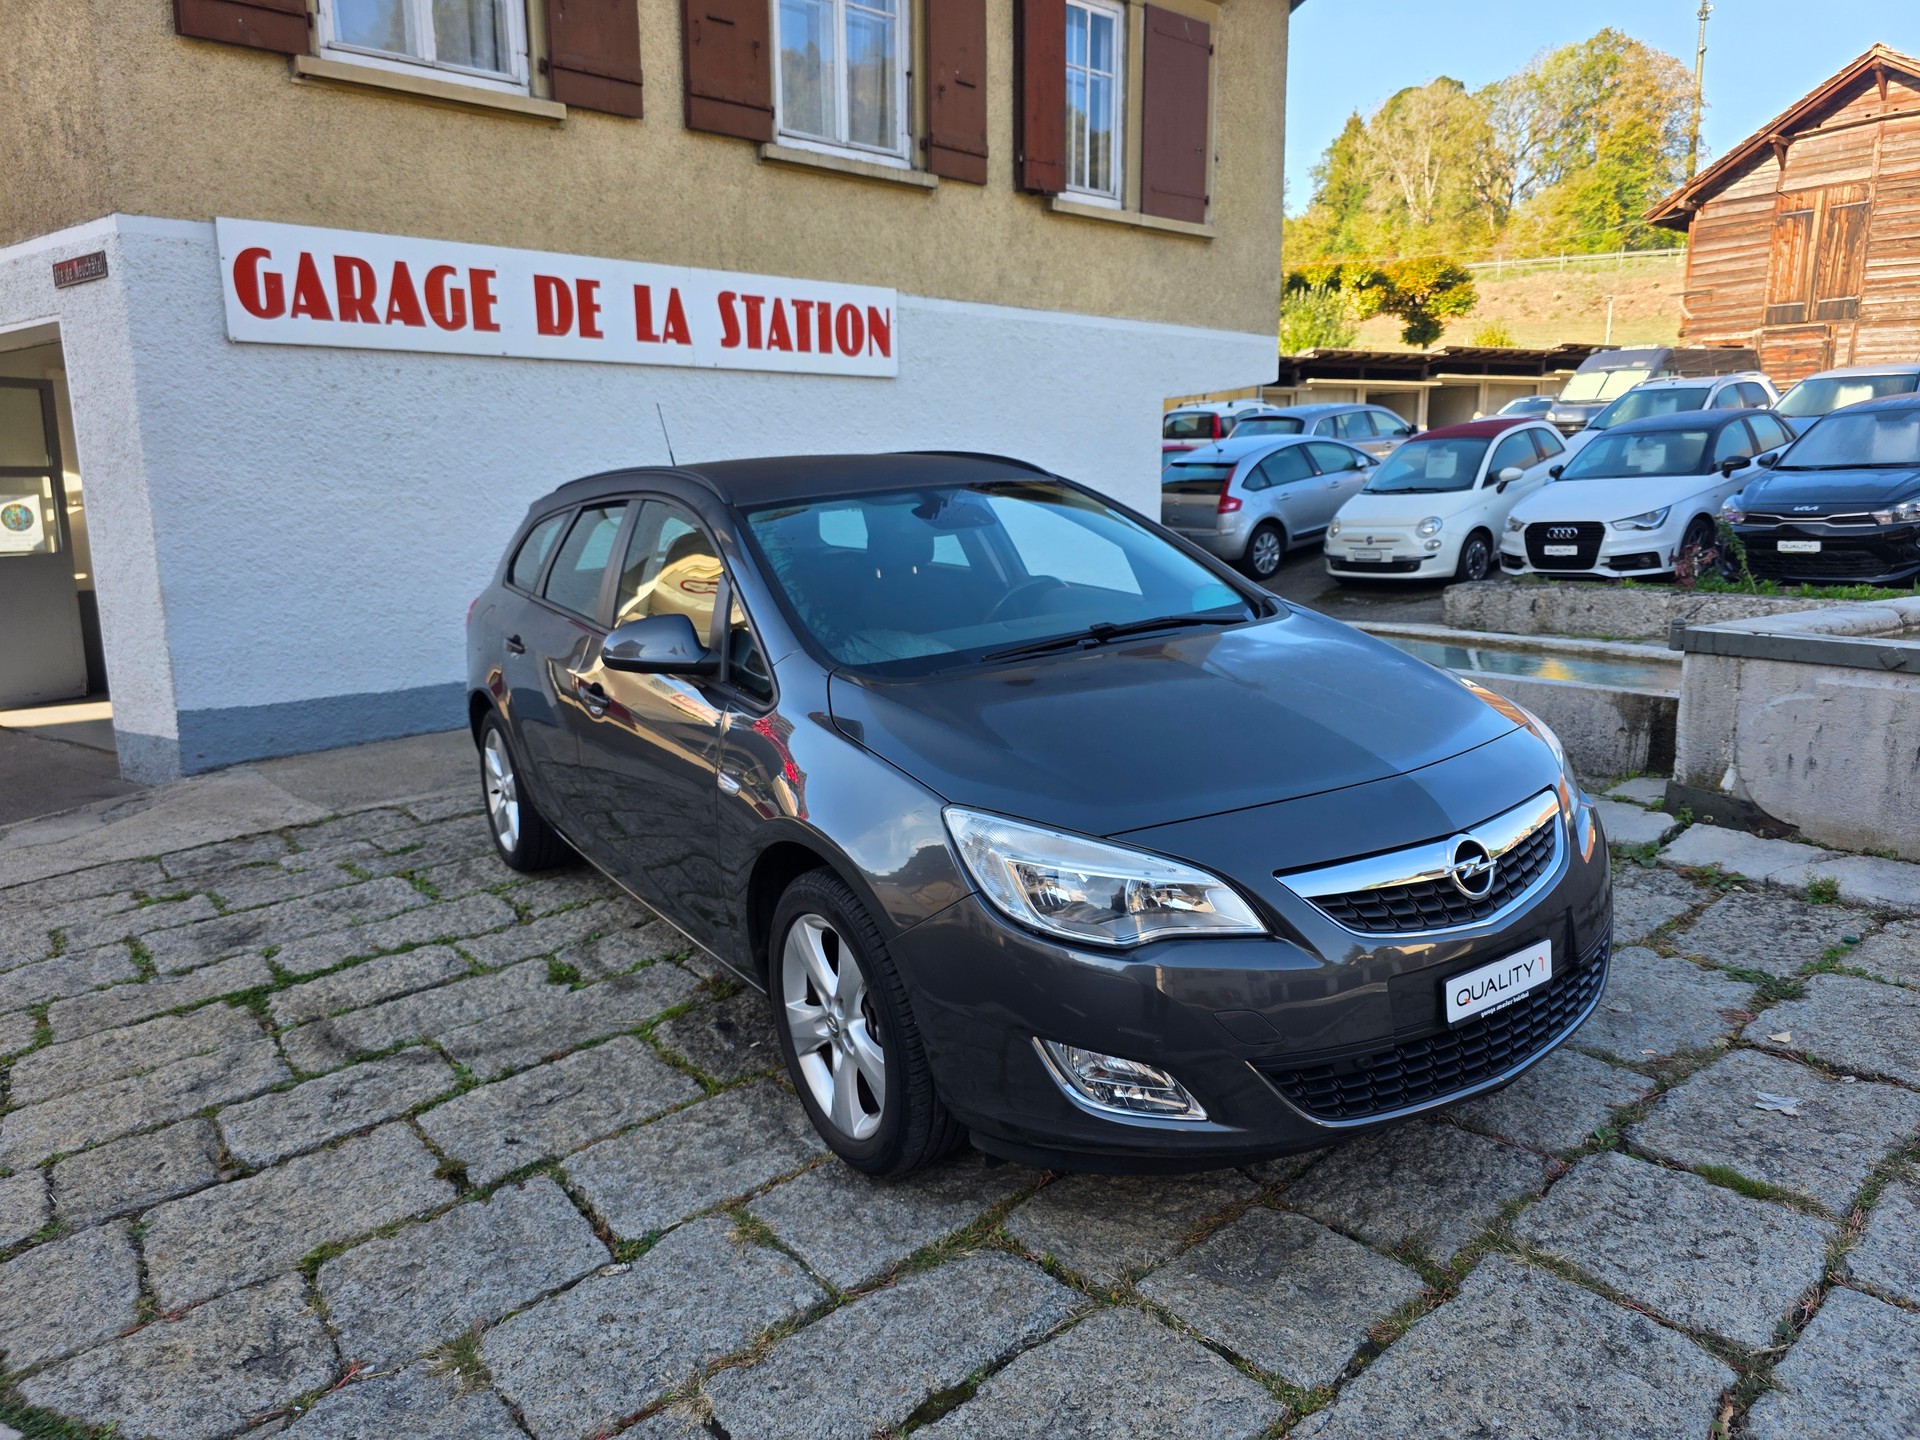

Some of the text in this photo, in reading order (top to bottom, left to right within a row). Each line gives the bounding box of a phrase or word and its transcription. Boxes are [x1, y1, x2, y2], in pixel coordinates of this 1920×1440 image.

[232, 247, 892, 357] GARAGE DE LA STATION
